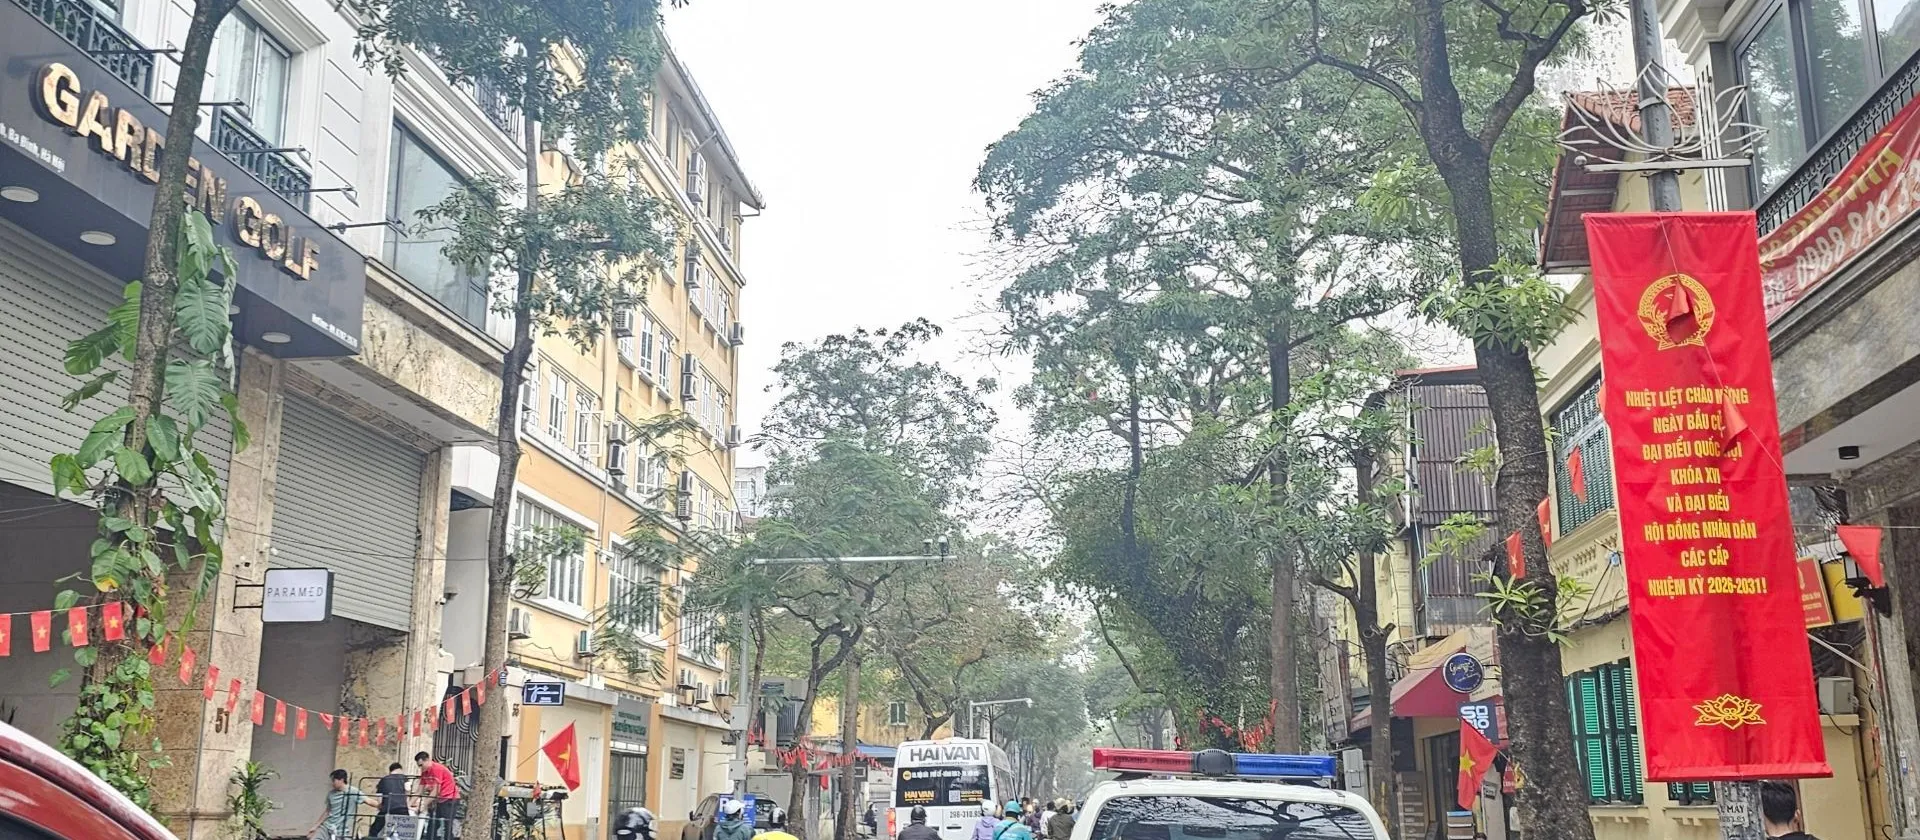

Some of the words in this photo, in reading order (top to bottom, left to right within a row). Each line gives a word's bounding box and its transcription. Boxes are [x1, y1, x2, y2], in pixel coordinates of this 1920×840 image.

[8, 127, 20, 144] Ba
[40, 62, 227, 225] GARDEN
[233, 196, 320, 281] GOLF
[1796, 226, 1846, 290] 0988
[1625, 388, 1657, 411] NHIỆT
[1659, 384, 1683, 409] LIỆT
[1685, 384, 1714, 405] CHÀO
[1653, 413, 1684, 434] NGÀY
[1686, 408, 1709, 432] BẦU
[1642, 444, 1662, 464] ĐẠI
[1664, 435, 1692, 459] BIỂU
[1694, 435, 1721, 458] QUỐC
[1670, 465, 1702, 485] KHÓA
[1704, 467, 1721, 484] XVI
[1666, 492, 1684, 512] VÀ
[1684, 494, 1707, 514] ĐẠI
[1707, 489, 1730, 512] BIỂU
[1644, 521, 1665, 545] HỘI
[1667, 517, 1701, 540] ĐỒNG
[1702, 518, 1732, 539] NHÂN
[1733, 519, 1758, 539] DÂN
[1680, 547, 1707, 567] CÁC
[1708, 543, 1730, 566] CẤP
[266, 586, 325, 599] PARAMED
[1648, 576, 1687, 599] NHIỆM
[1688, 574, 1705, 595] KỲ
[215, 706, 230, 734] 51
